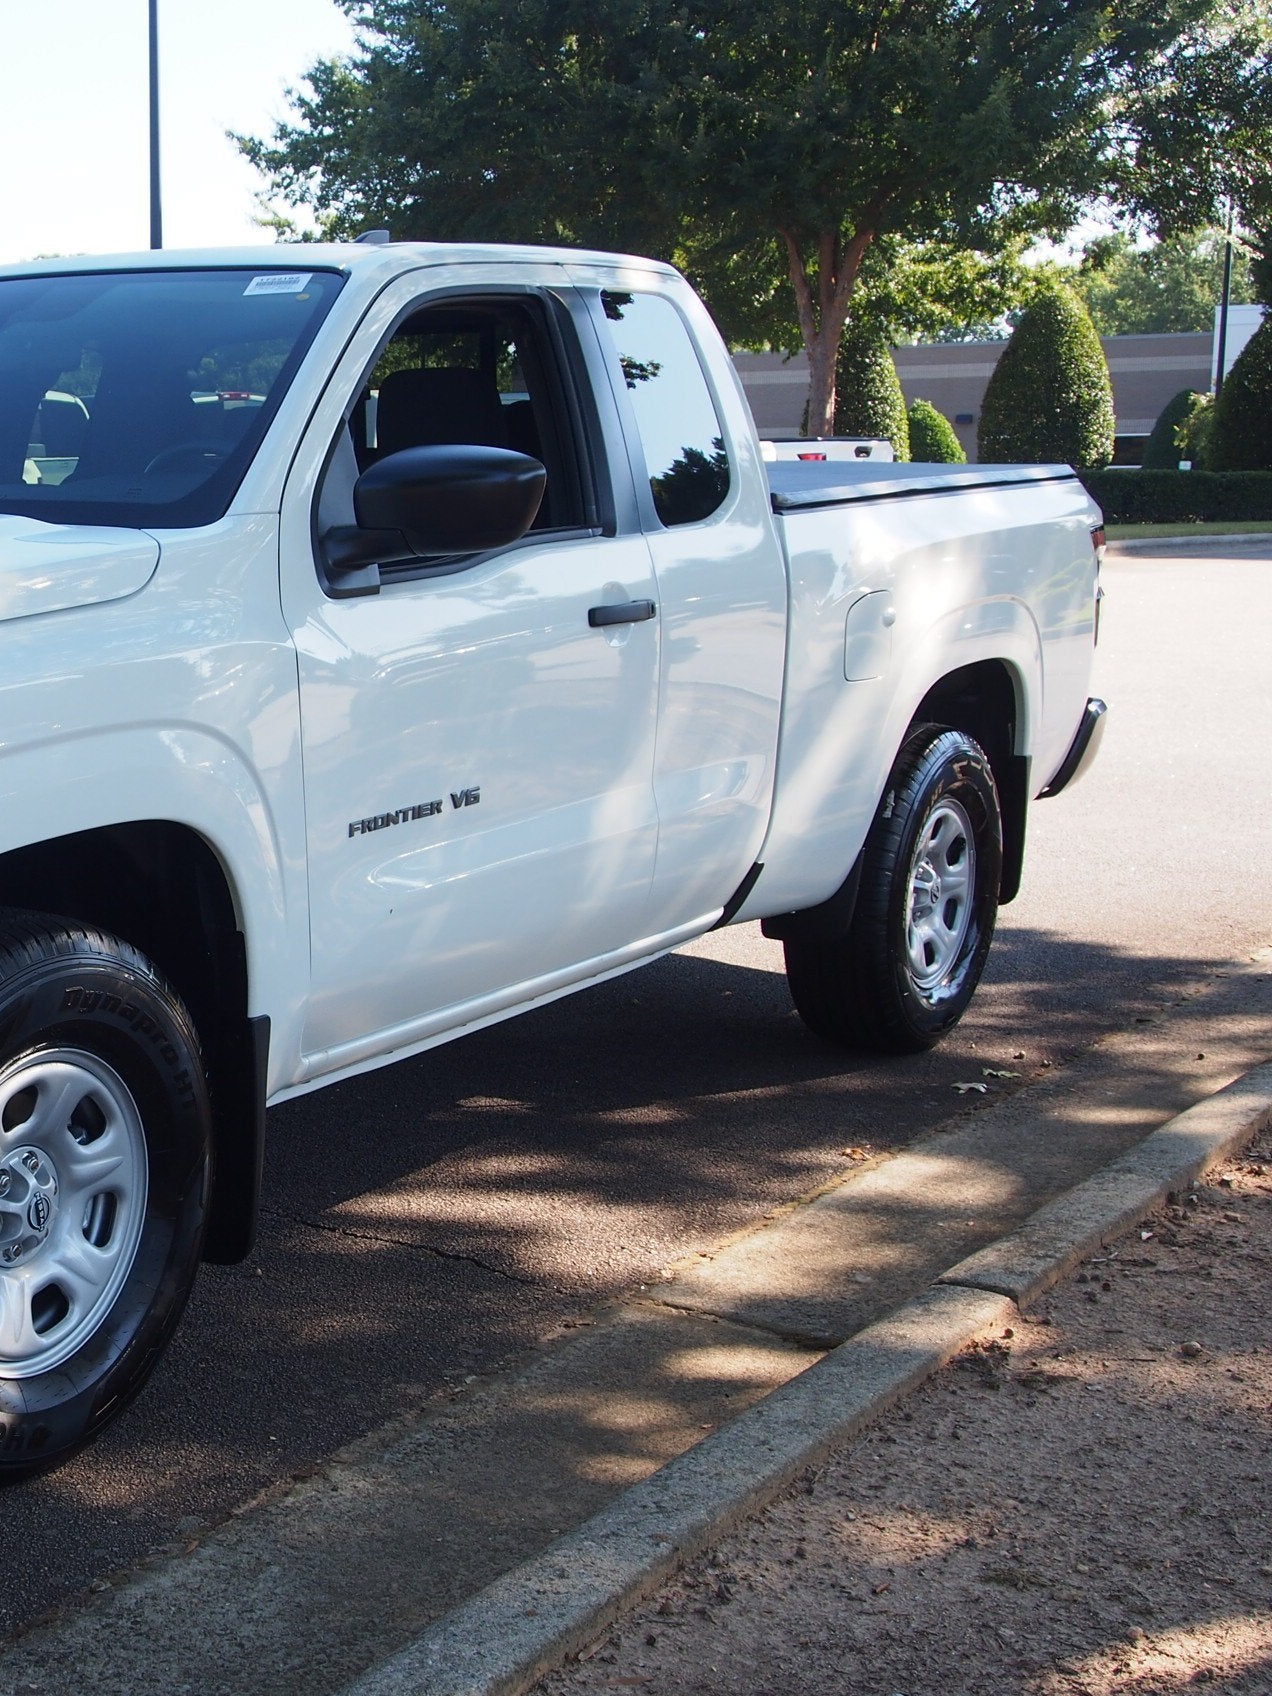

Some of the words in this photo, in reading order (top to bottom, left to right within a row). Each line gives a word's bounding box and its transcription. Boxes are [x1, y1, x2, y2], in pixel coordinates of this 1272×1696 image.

[348, 799, 443, 838] FRONTIER
[449, 786, 481, 810] V6
[34, 1191, 45, 1233] NISSAN
